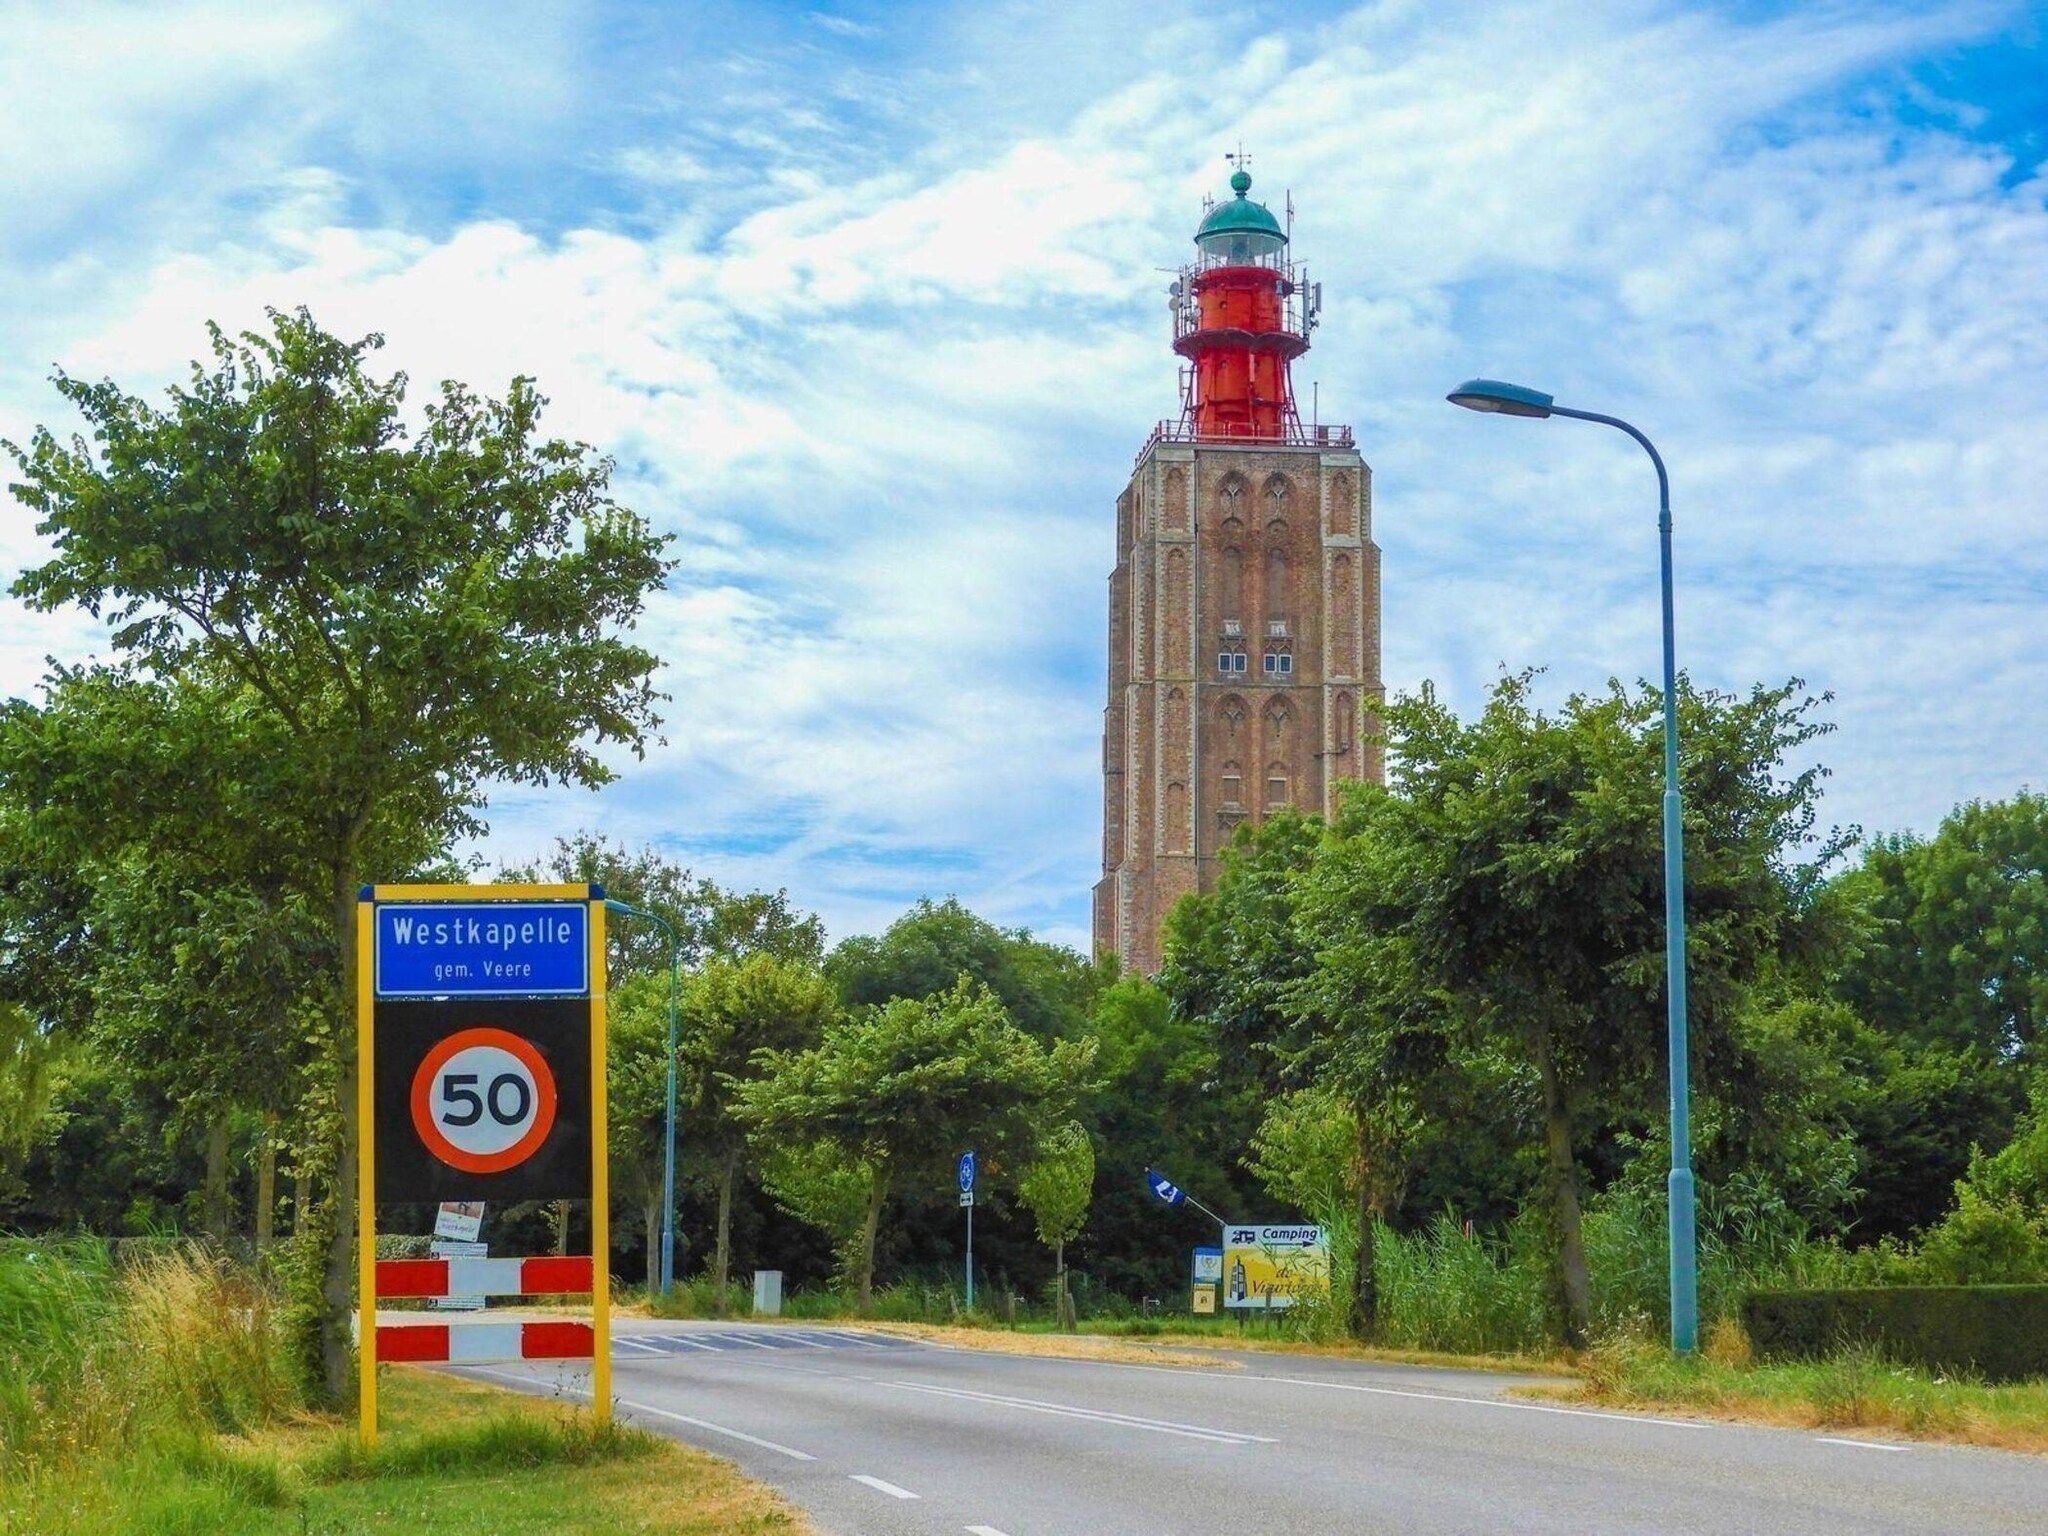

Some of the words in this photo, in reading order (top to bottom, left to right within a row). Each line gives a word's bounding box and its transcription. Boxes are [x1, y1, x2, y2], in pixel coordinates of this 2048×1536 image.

[393, 917, 571, 951] Westkapelle
[434, 963, 474, 981] gem.
[483, 961, 531, 977] Veere
[442, 1073, 531, 1127] 50
[1262, 1228, 1318, 1241] Camping
